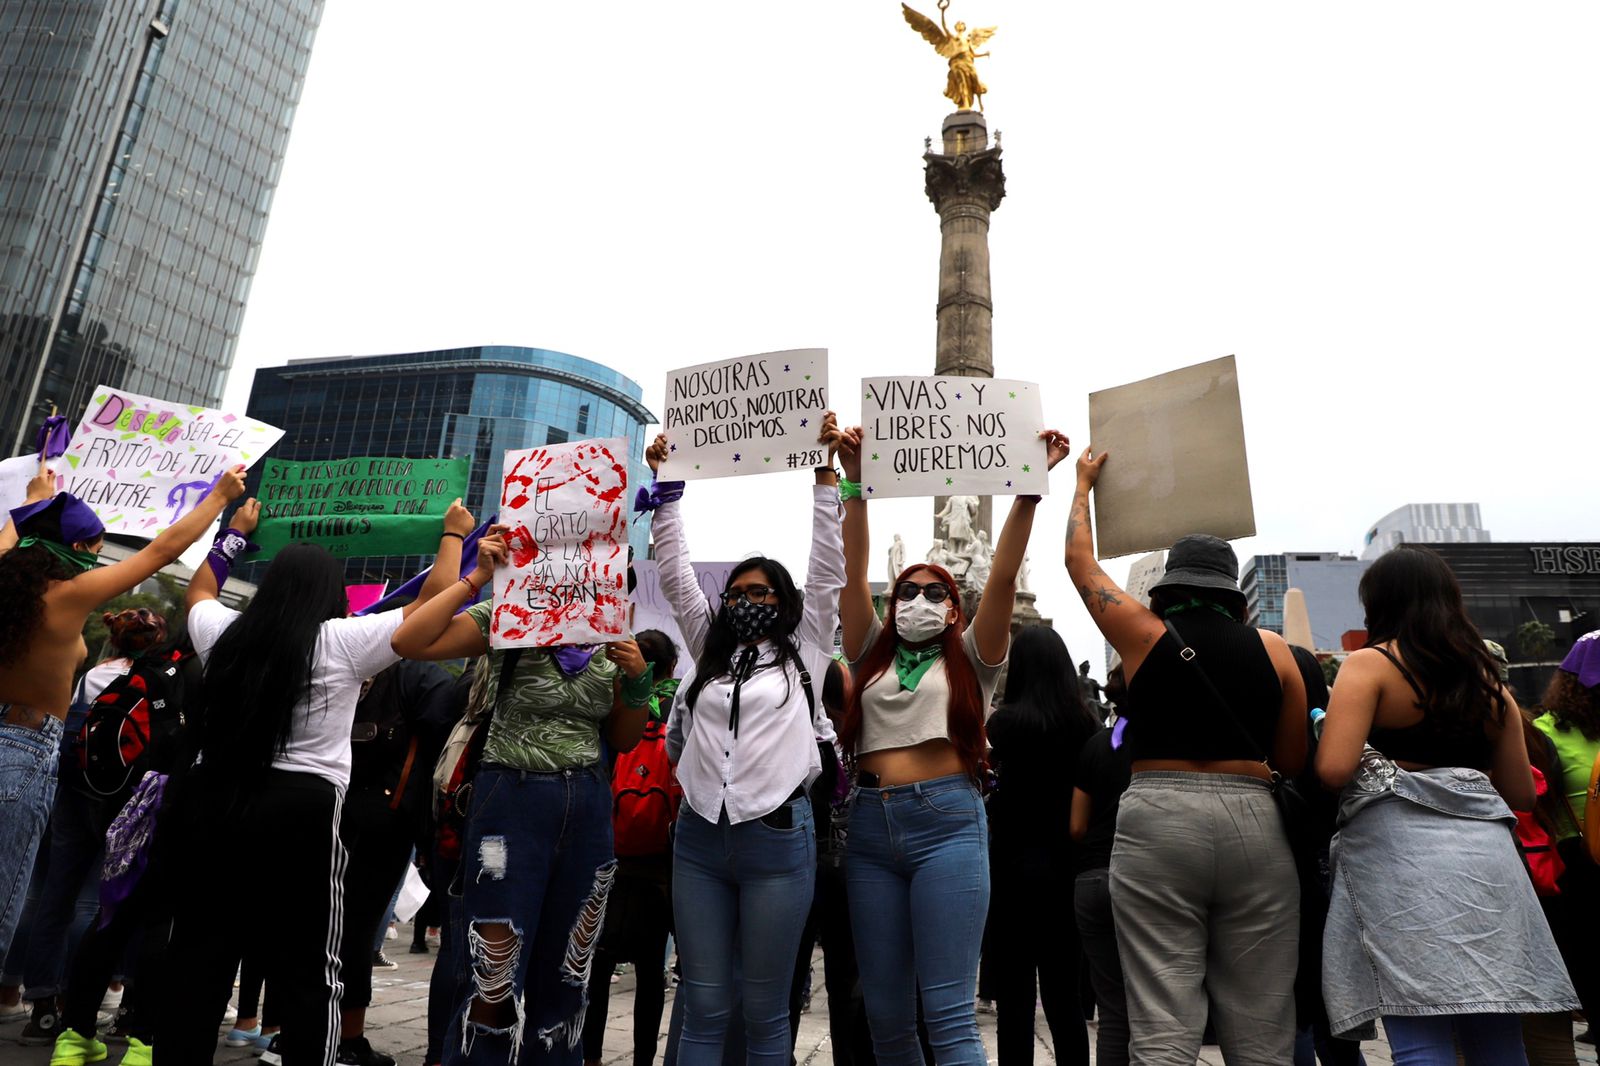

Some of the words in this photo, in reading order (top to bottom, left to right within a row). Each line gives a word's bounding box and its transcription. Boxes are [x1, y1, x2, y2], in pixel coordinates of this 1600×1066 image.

[674, 360, 770, 401] NOSOTRAS
[869, 380, 947, 411] VIVAS
[971, 383, 986, 406] Y
[747, 387, 826, 418] NOSOTRAS
[181, 420, 214, 443] SEA
[218, 428, 245, 449] EL
[875, 415, 952, 441] LIBRES
[967, 412, 1006, 438] NOS
[83, 437, 151, 468] FRUTO
[156, 451, 180, 472] DE
[190, 453, 217, 475] TU
[893, 443, 1010, 474] QUEREMOS.
[69, 475, 156, 509] VIENTRE
[534, 476, 555, 514] EL
[534, 511, 588, 543] GRITO
[532, 544, 553, 565] DE
[564, 544, 592, 563] LAS
[533, 563, 555, 586] YA
[565, 563, 589, 584] NO
[526, 581, 598, 610] ESTAN
